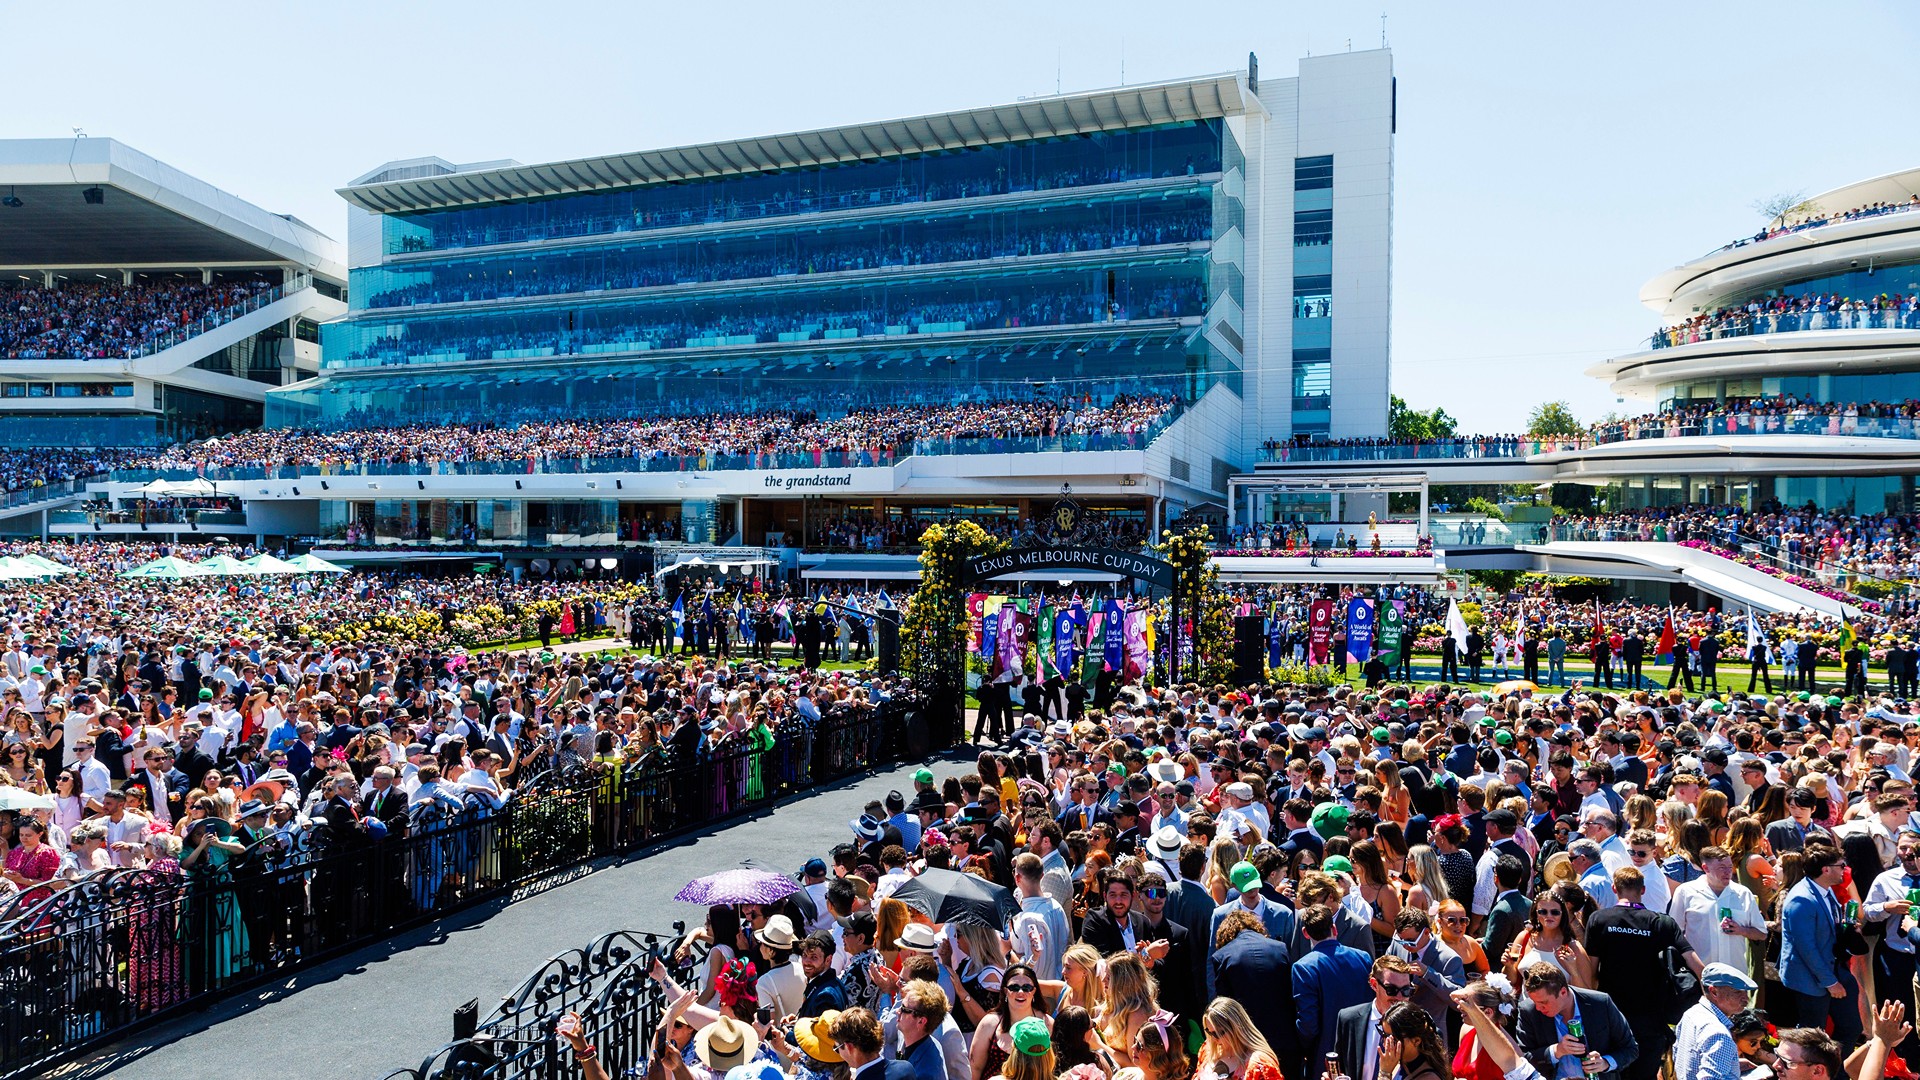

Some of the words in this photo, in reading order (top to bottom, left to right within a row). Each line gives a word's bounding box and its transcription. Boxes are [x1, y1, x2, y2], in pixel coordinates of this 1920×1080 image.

[764, 475, 782, 487] the
[785, 474, 851, 490] grandstand
[974, 555, 1013, 575] LEXUS
[1019, 550, 1100, 565] MELBOURNE
[1103, 554, 1131, 569] CUP
[1132, 560, 1161, 578] DAY
[1607, 926, 1651, 936] BROADCAST
